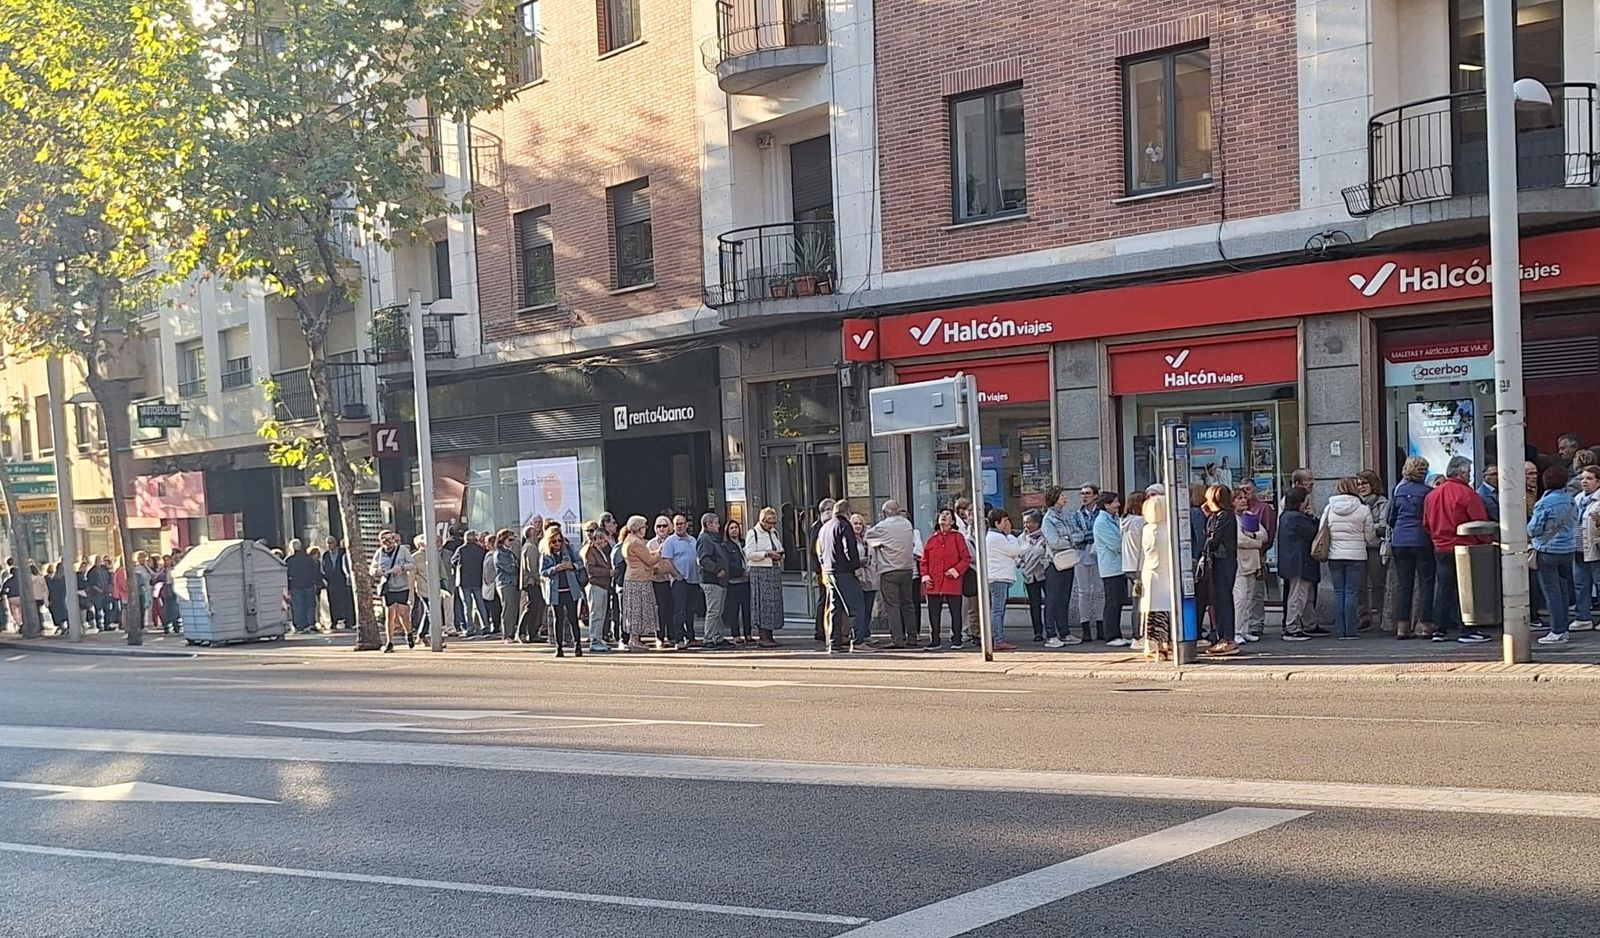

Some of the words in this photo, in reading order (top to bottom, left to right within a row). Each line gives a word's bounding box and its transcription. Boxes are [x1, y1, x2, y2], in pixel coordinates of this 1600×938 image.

[1519, 262, 1561, 281] iajes
[943, 316, 1016, 343] Halcón
[1016, 320, 1053, 336] viajes
[1391, 350, 1419, 359] MALETAS
[1425, 346, 1460, 356] ARTÍCULOS
[1471, 343, 1489, 352] VIAJE
[1420, 363, 1469, 376] acerbag
[1164, 369, 1217, 387] Halcón
[1217, 372, 1244, 384] viajes
[987, 391, 1009, 402] viajes
[629, 405, 694, 426] renta4banco
[1423, 419, 1458, 428] ESPECIAL
[1196, 429, 1237, 440] IMSERSO
[89, 515, 111, 526] ORO
